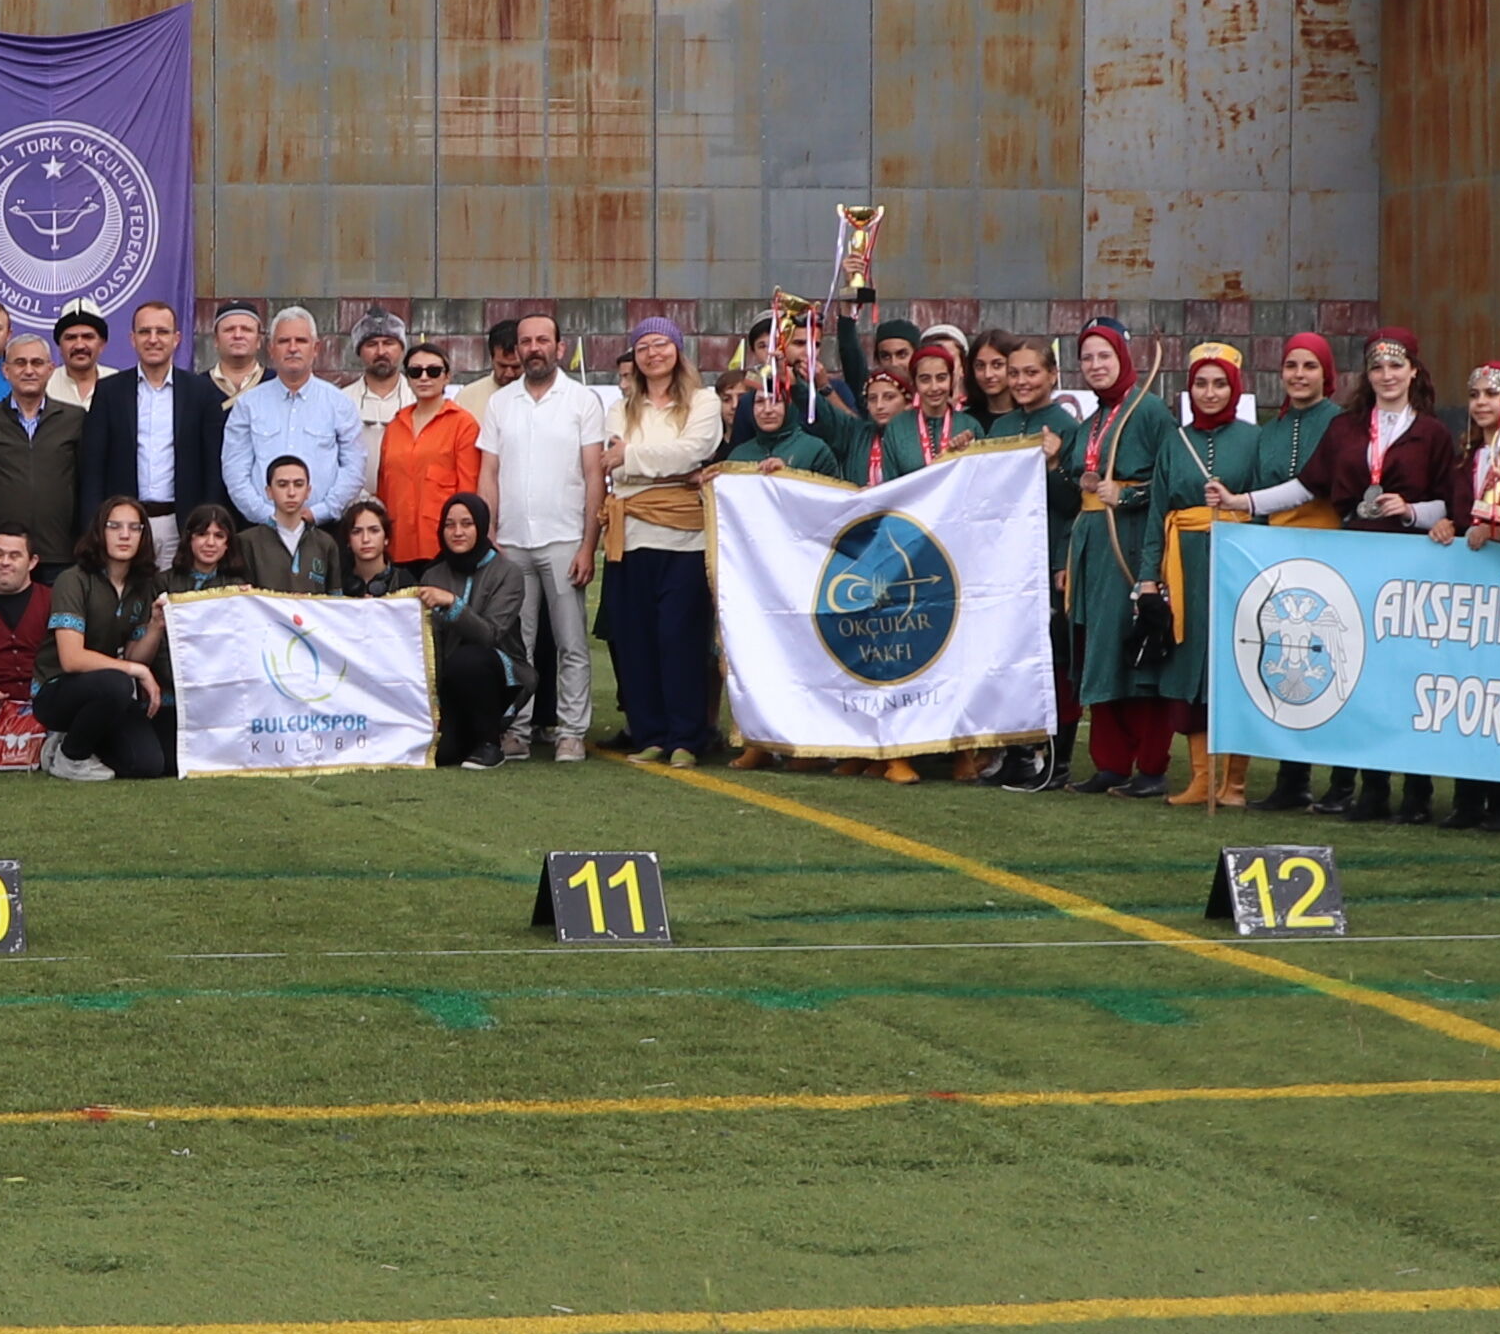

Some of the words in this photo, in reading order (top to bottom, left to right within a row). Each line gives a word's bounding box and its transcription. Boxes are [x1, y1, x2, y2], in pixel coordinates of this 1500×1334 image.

[14, 136, 64, 159] TÜRK
[70, 138, 138, 201] OKÇULUK
[838, 613, 932, 640] OKÇULAR
[858, 643, 913, 663] VAKFI
[841, 689, 942, 713] İSTANBUL
[568, 860, 646, 934] 11
[1238, 857, 1335, 928] 12
